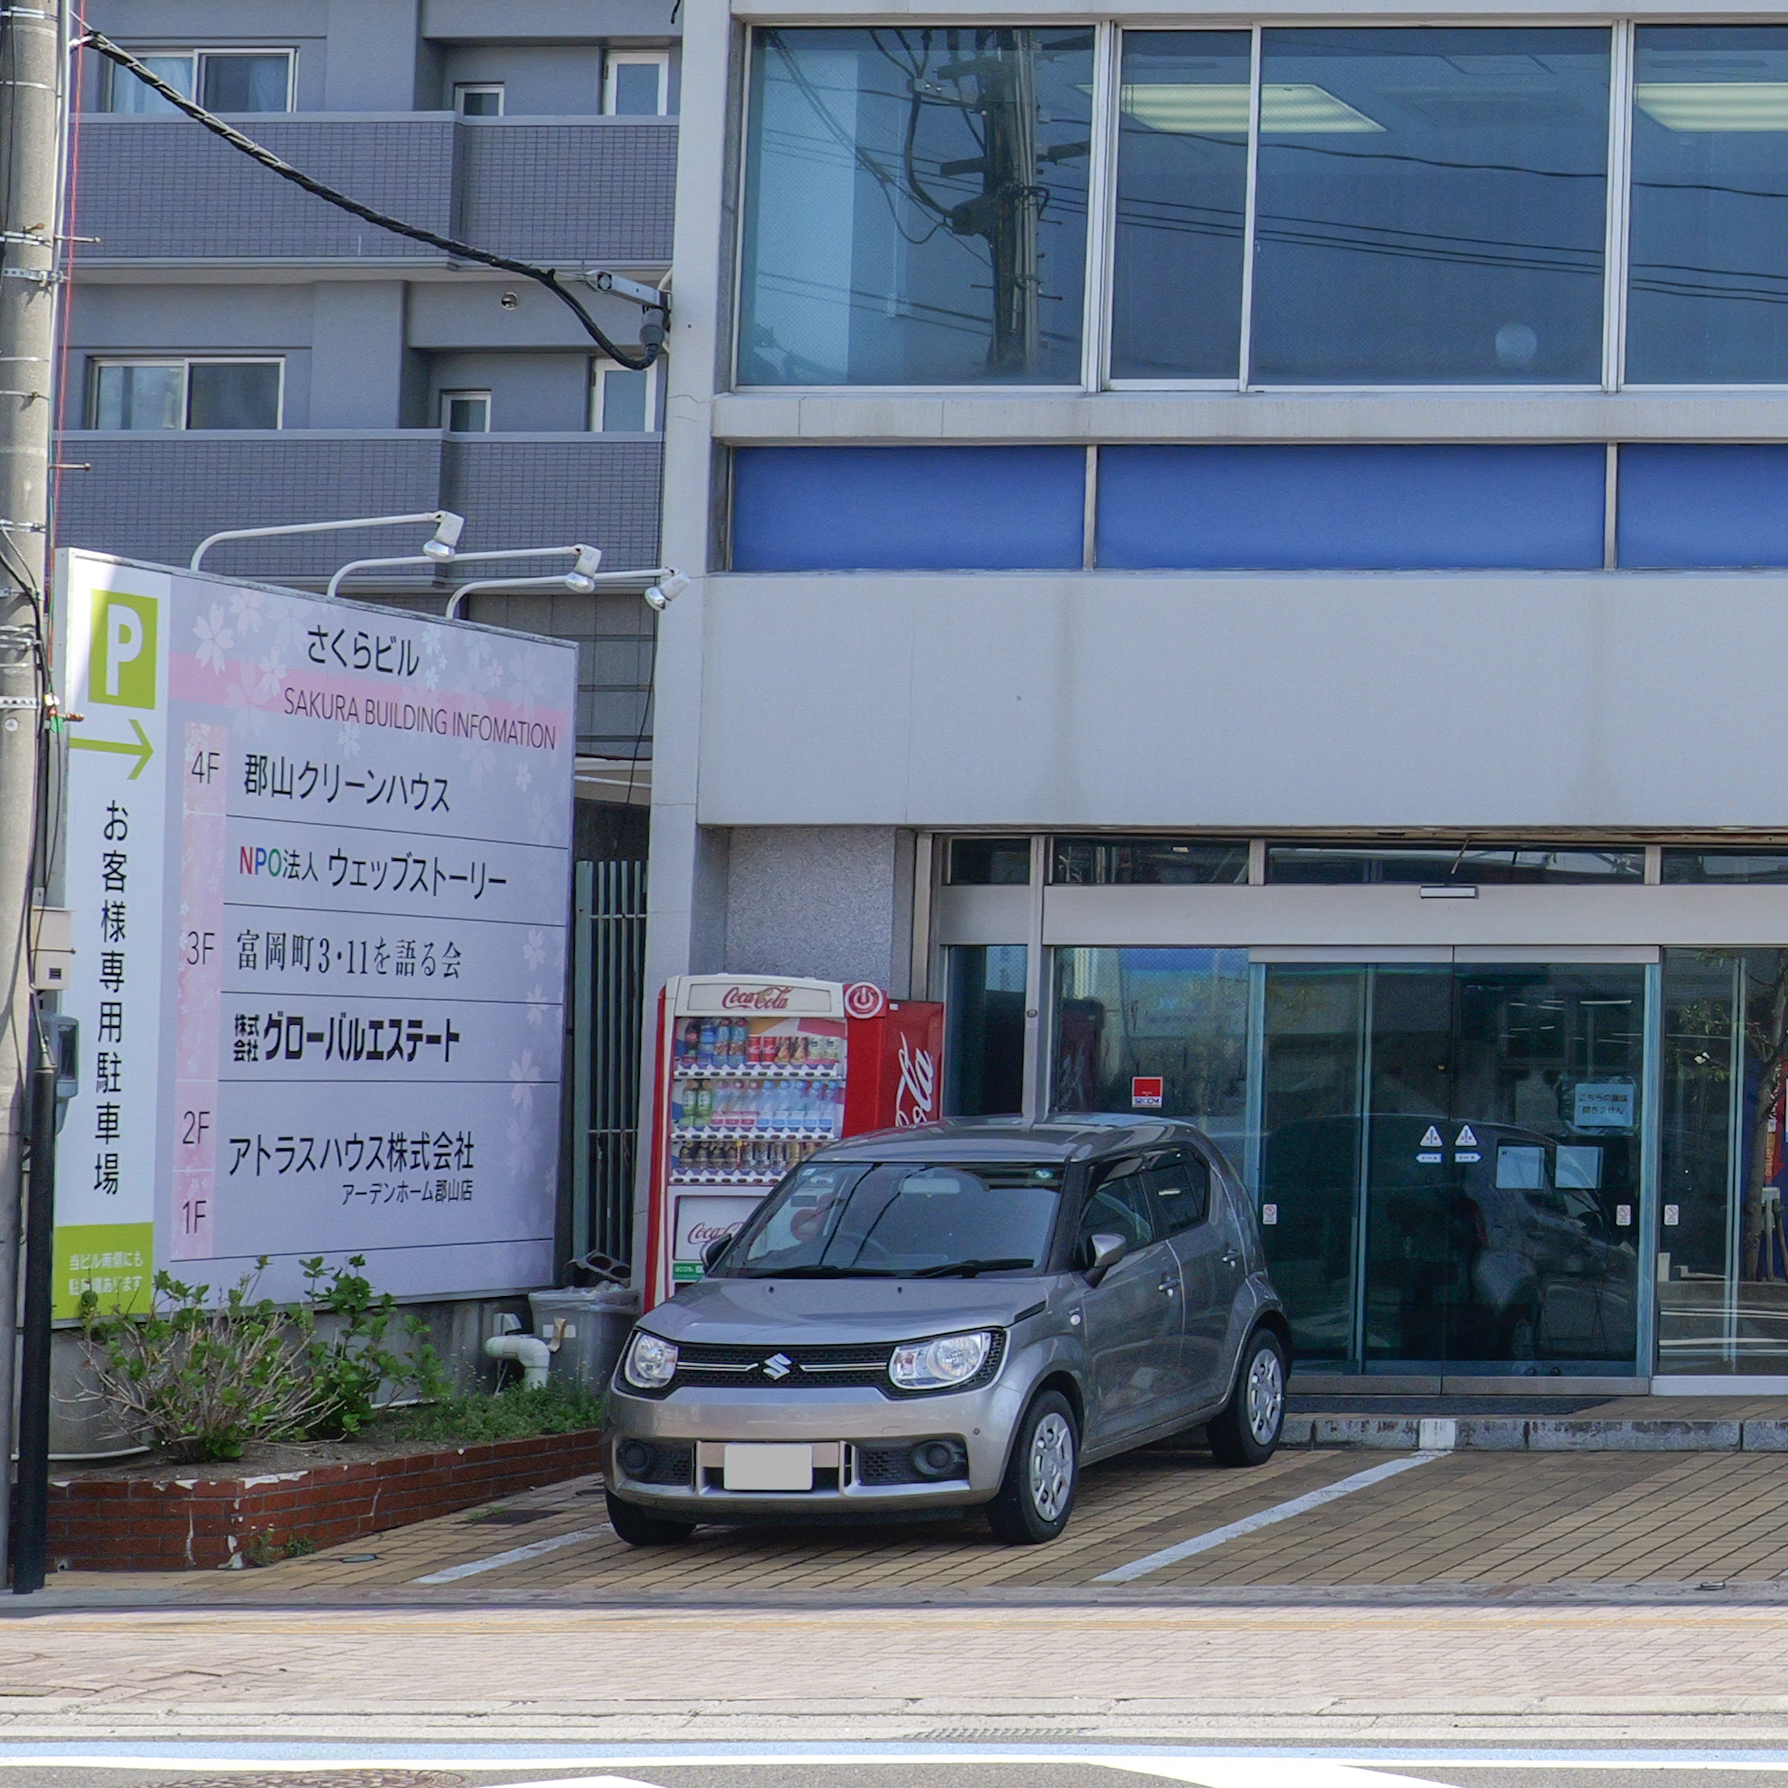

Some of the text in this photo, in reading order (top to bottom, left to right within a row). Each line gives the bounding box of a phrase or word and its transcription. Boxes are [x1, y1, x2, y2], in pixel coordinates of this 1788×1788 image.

[106, 604, 143, 697] P
[307, 624, 420, 678] さくらビル
[283, 687, 557, 752] SAKURA BUILDING INFOMATION
[191, 751, 451, 813] 4F 郡山クリーンハウス
[239, 845, 319, 883] NPO法人
[187, 931, 216, 965] 3F
[93, 799, 129, 1195] お客様専用駐車場
[264, 1011, 461, 1062] グローバルエステート
[182, 1111, 211, 1144] 2F
[229, 1130, 475, 1177] アトラスハウス株式会社
[182, 1200, 207, 1234] 1F
[342, 1179, 474, 1206] アーデンホーム郡山店
